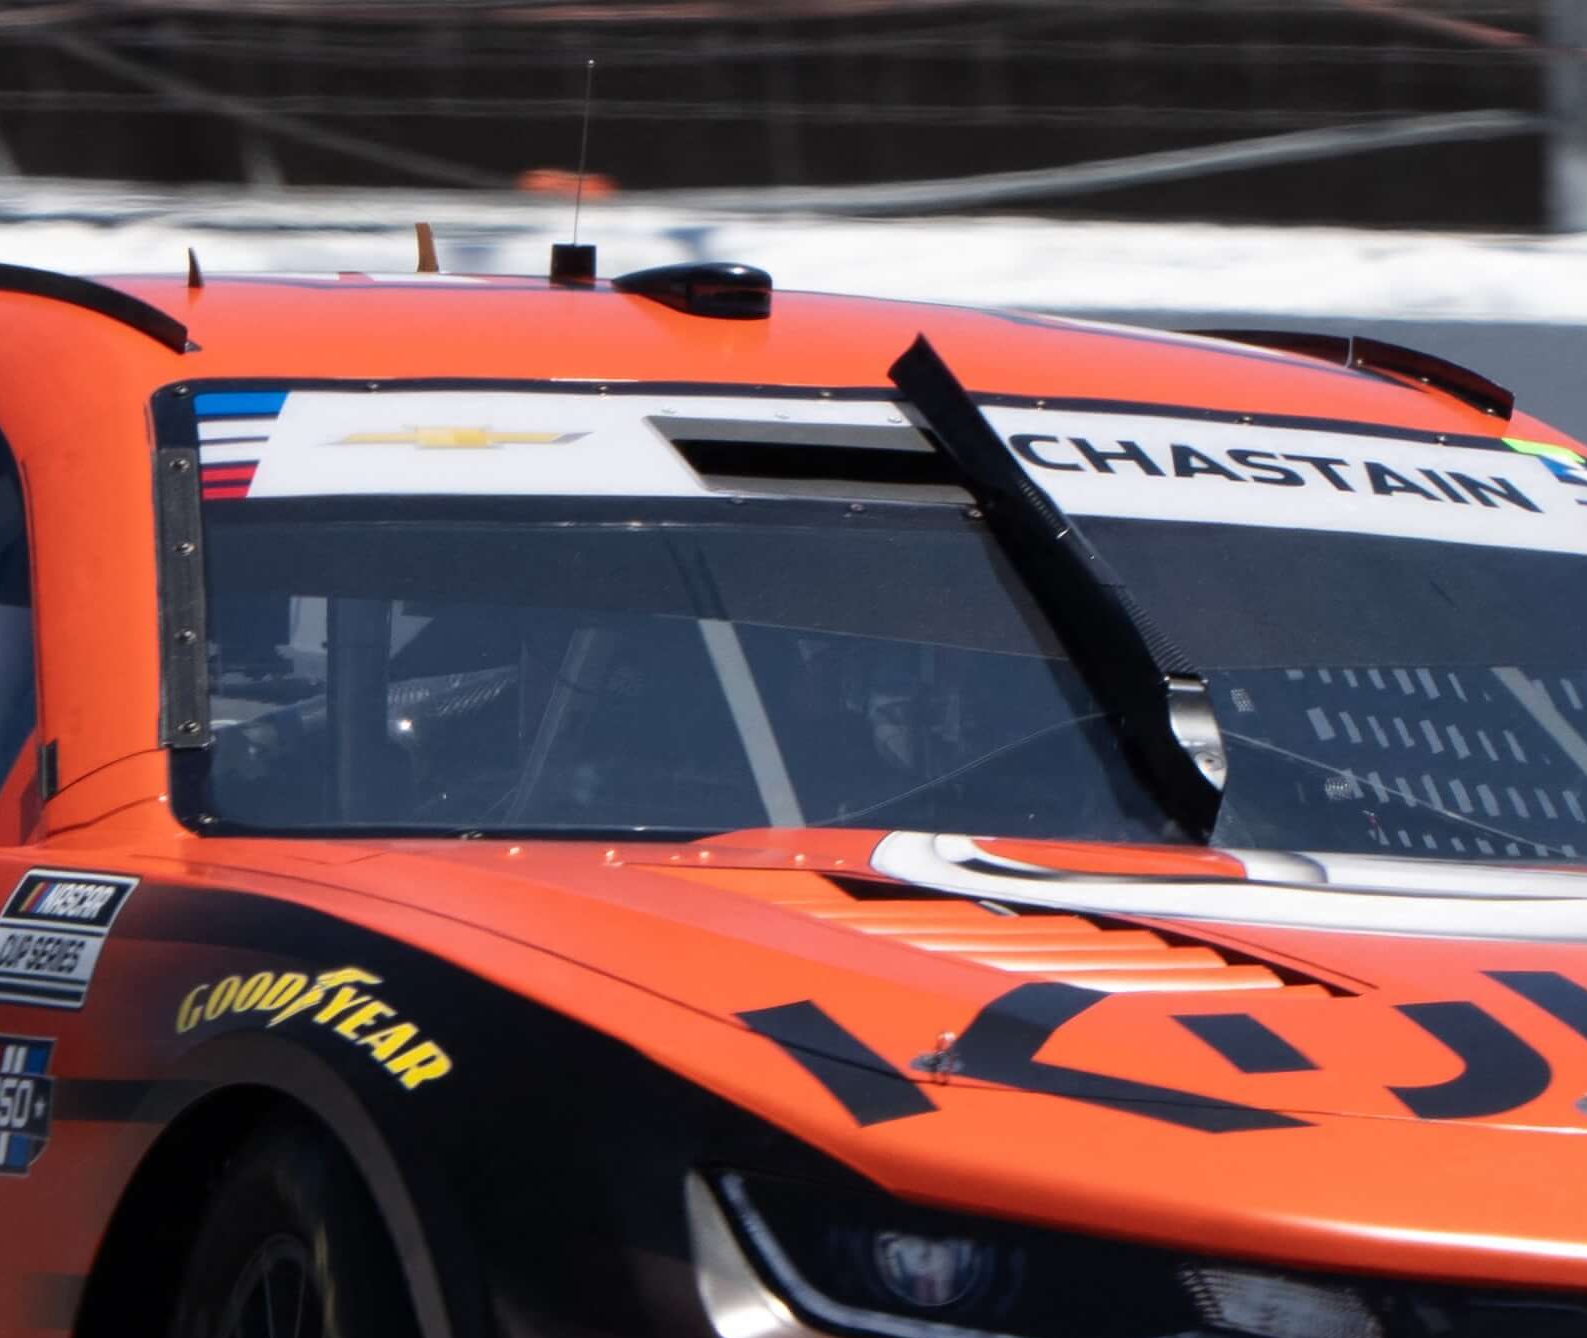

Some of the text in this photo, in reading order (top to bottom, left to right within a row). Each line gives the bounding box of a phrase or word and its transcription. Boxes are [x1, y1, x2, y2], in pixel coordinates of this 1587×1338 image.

[1008, 433, 1544, 514] CHASTAIN
[42, 881, 117, 919] NASCAR
[25, 936, 86, 975] SERIES
[176, 965, 453, 1091] GOODYEAR
